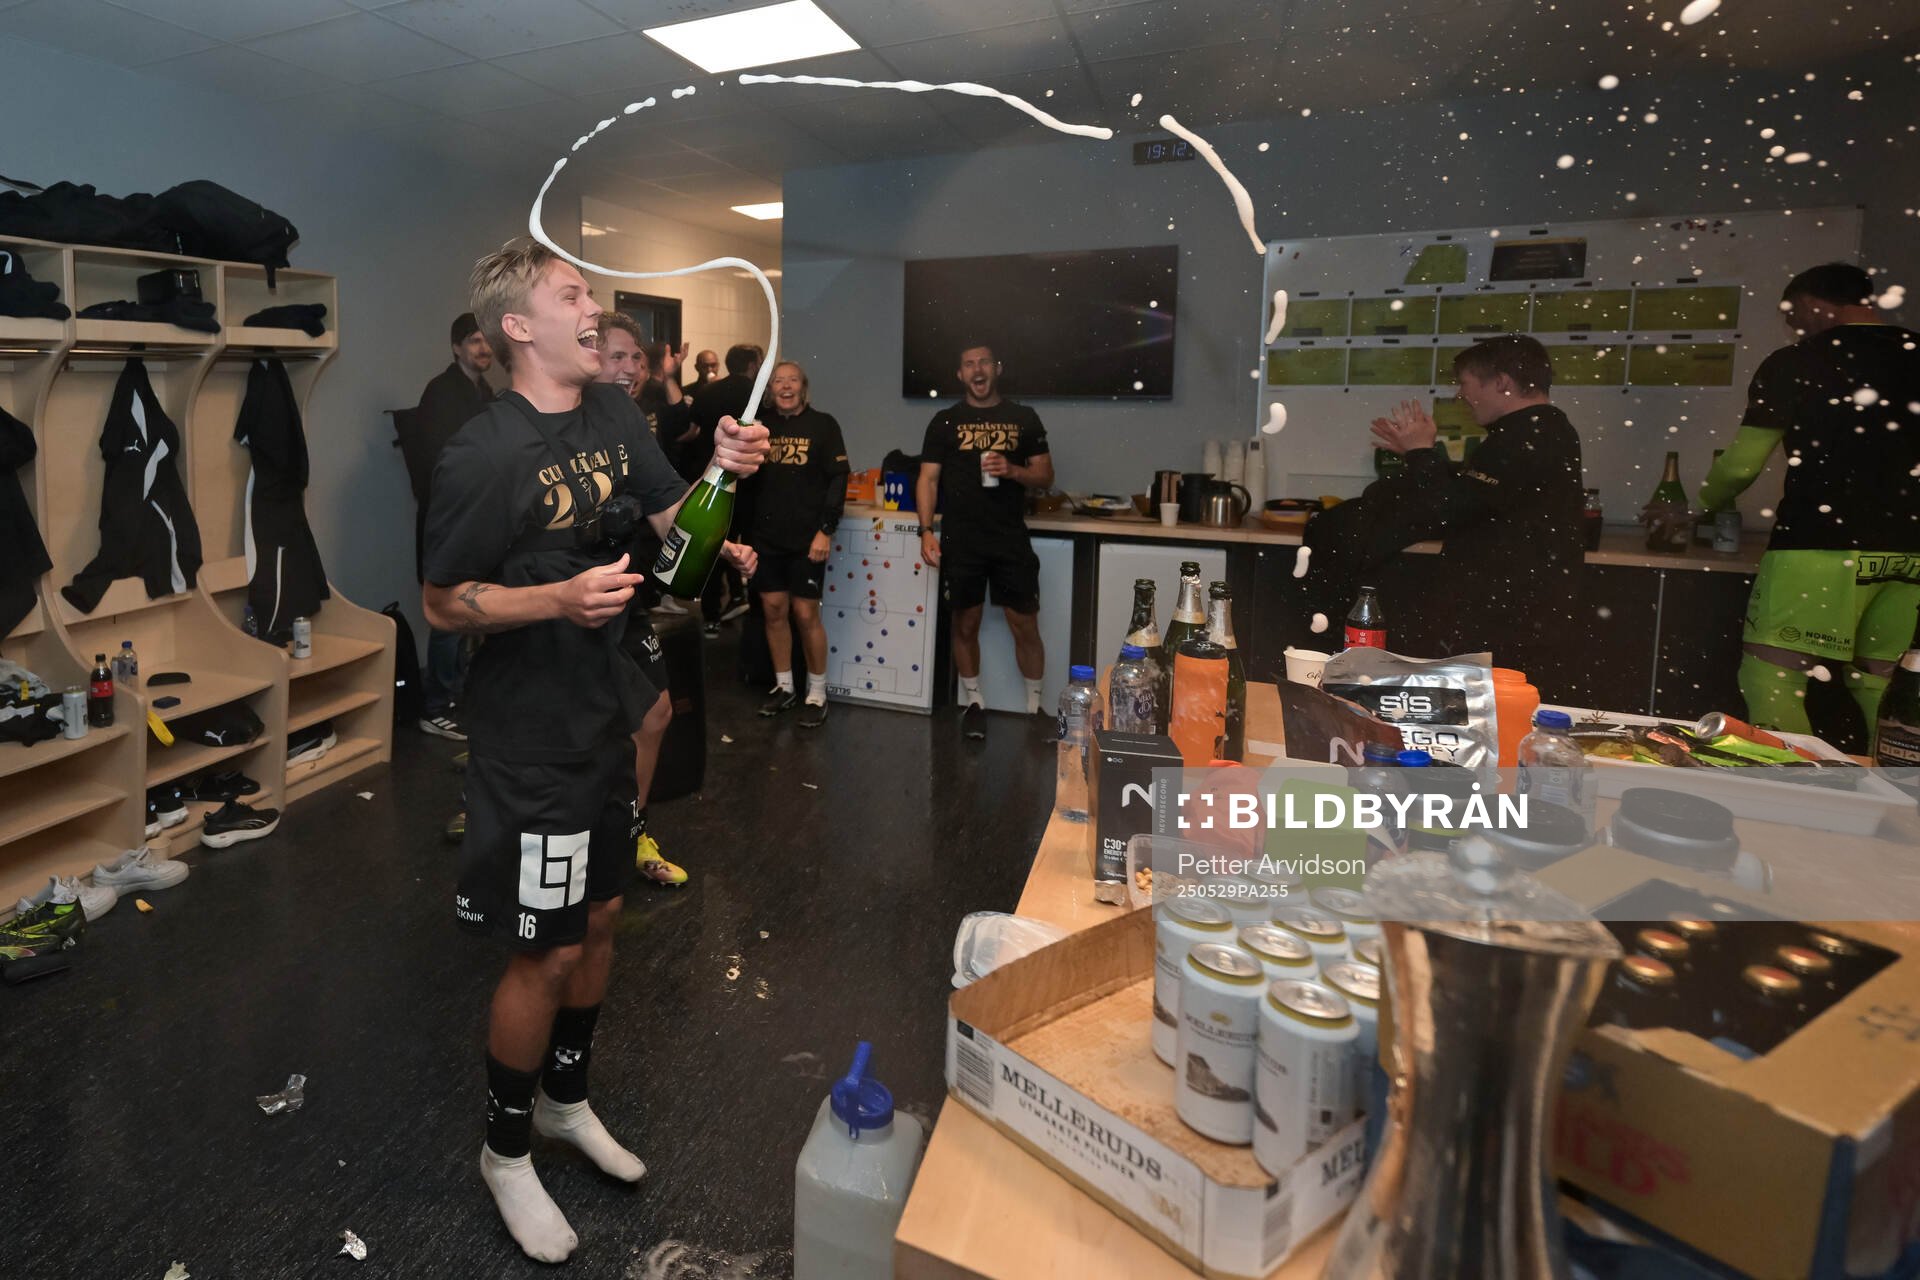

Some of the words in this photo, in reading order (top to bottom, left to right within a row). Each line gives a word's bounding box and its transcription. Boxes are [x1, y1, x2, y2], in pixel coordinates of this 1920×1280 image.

[1805, 630, 1851, 646] NORDIK
[518, 912, 537, 940] 16
[1000, 1063, 1163, 1181] MELLERUDS
